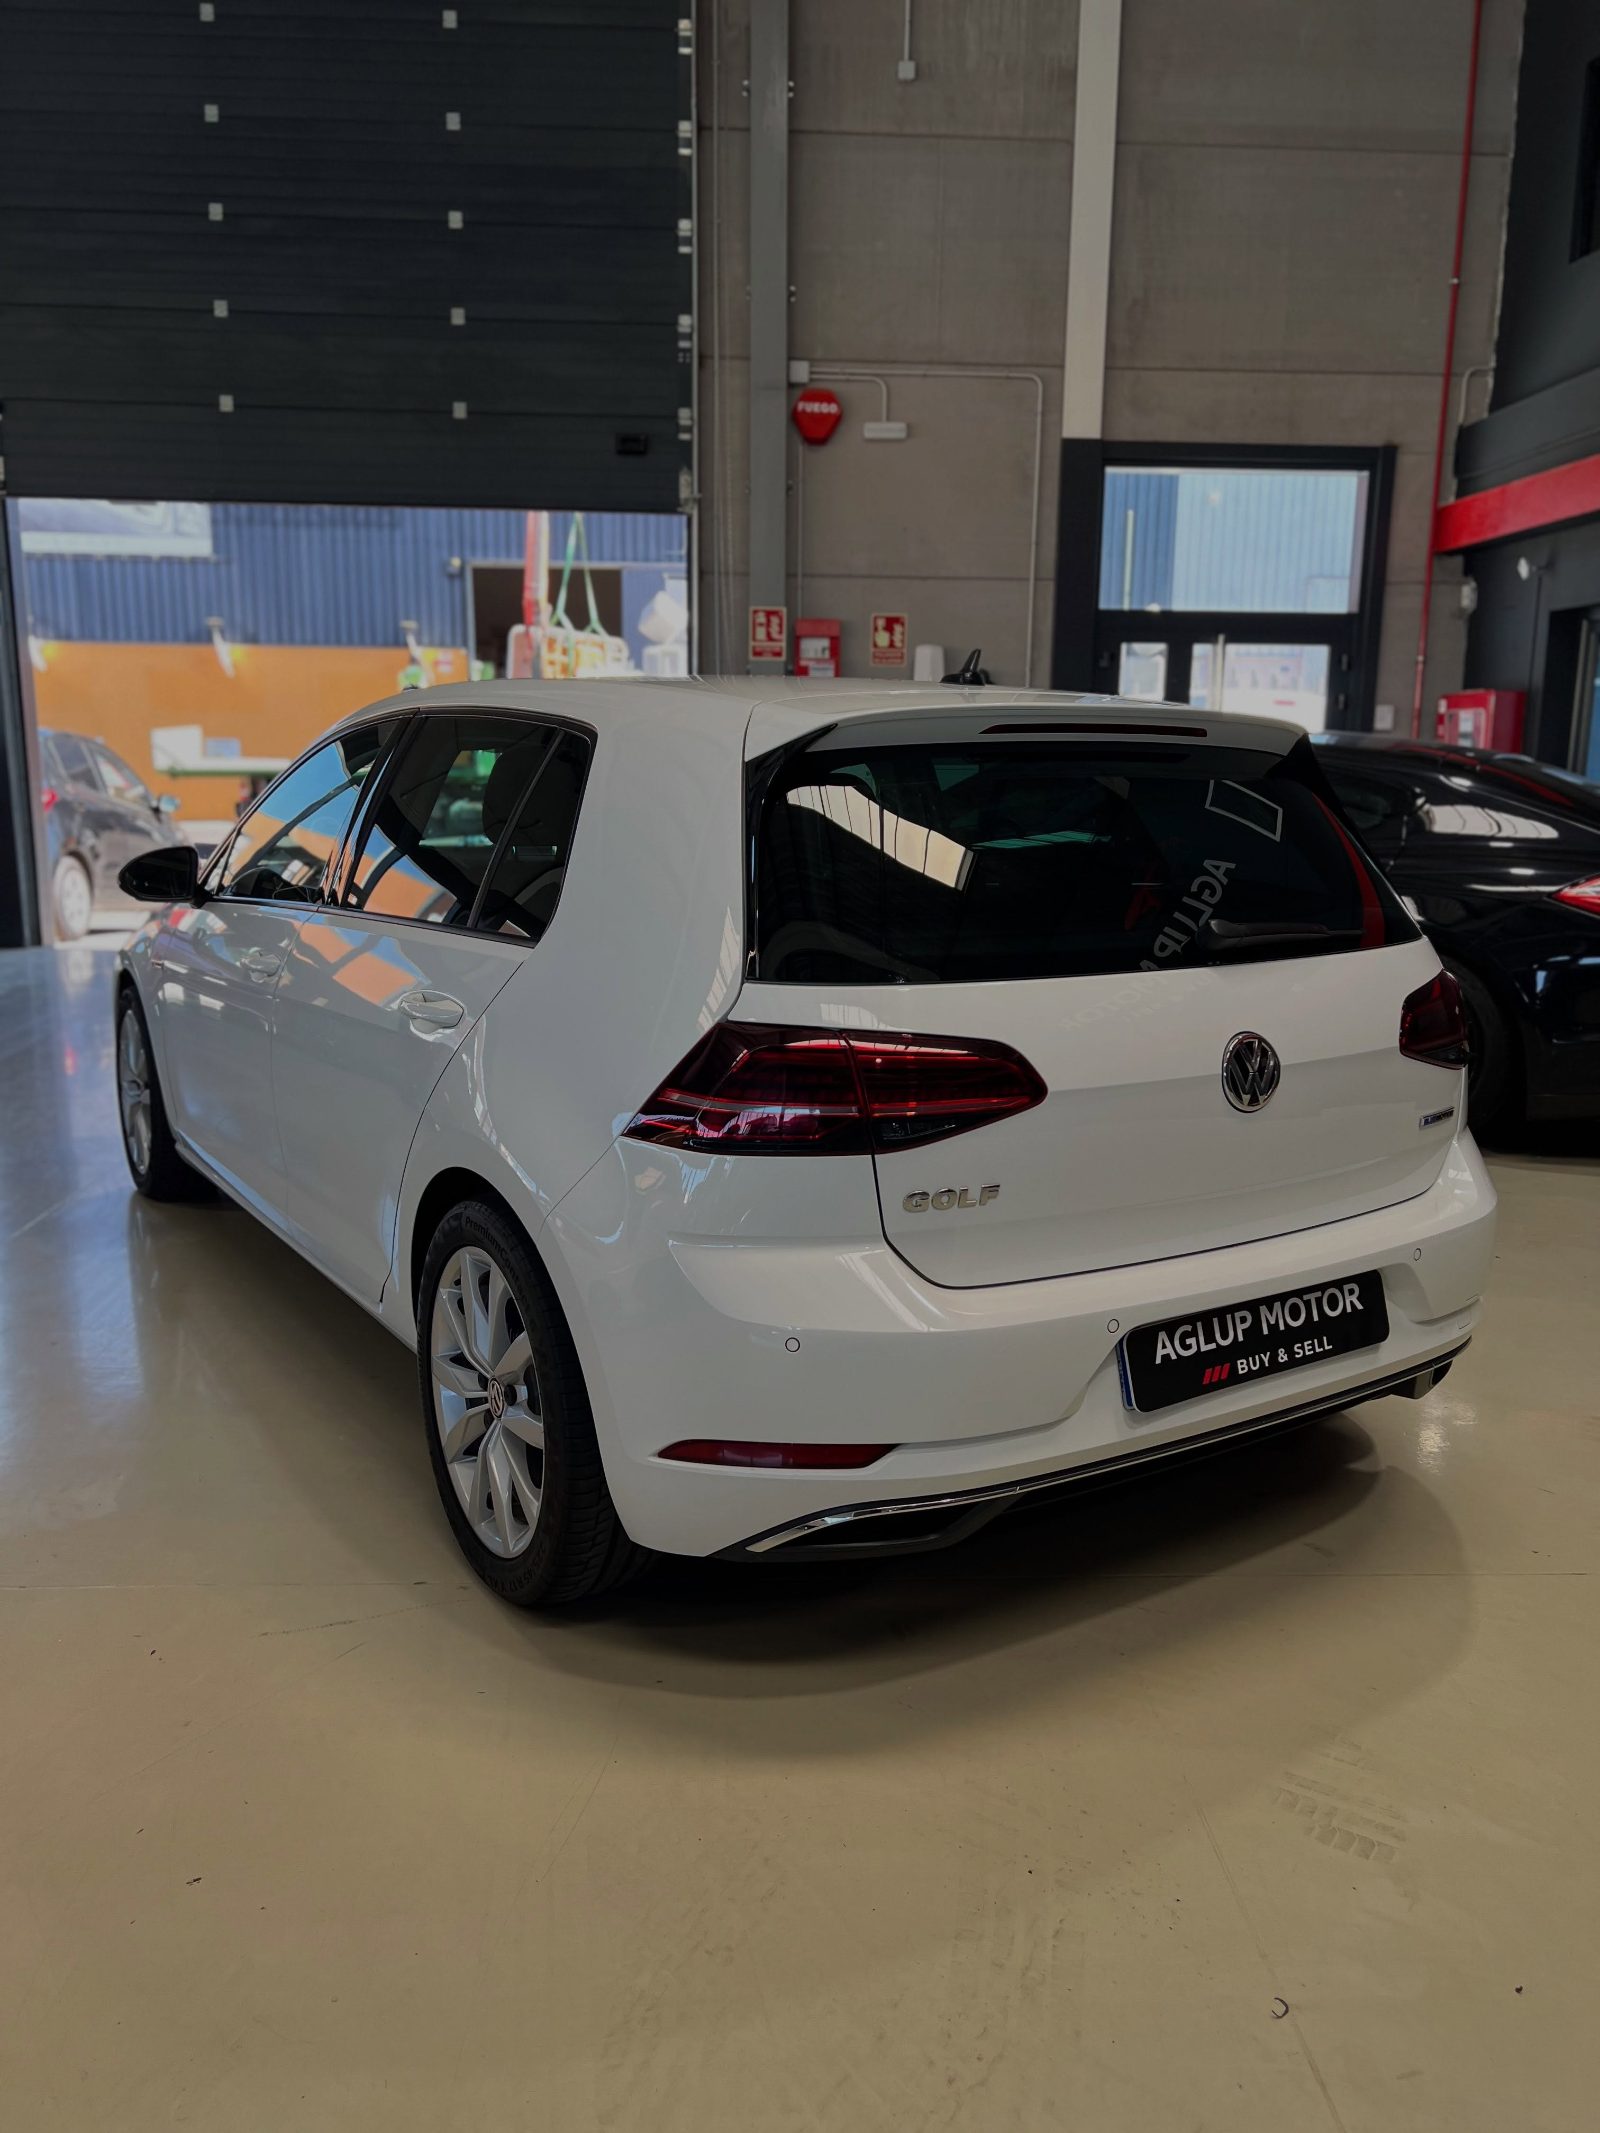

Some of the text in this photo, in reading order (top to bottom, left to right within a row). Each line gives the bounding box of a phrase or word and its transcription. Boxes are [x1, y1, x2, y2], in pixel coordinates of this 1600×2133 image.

[797, 401, 838, 415] FUEGO
[902, 1183, 1001, 1213] GOLF
[1155, 1283, 1364, 1365] AGLUP MOTOR
[1237, 1336, 1333, 1375] BUY & SELL
